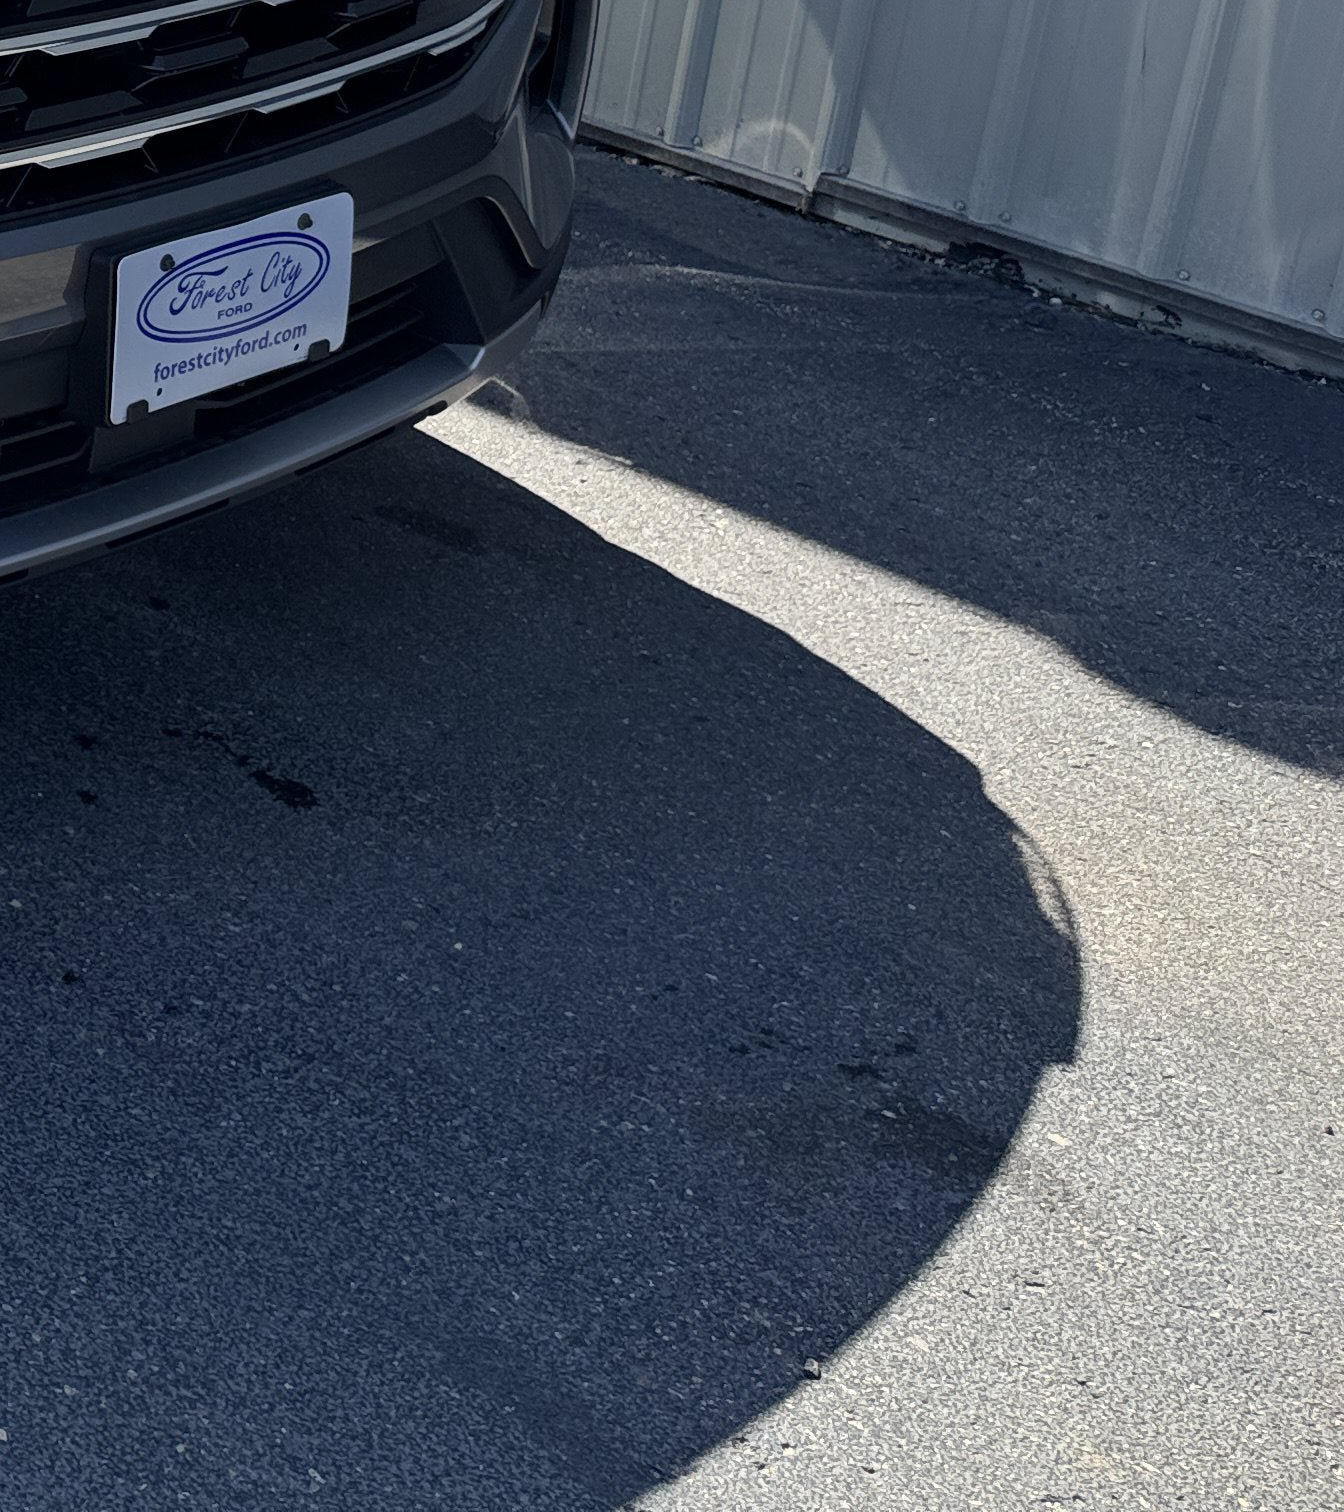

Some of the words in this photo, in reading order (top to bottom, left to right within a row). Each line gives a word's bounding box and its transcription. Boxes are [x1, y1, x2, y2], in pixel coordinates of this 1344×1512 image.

[168, 265, 254, 316] Forest
[260, 250, 303, 299] City
[216, 302, 254, 320] FORD
[153, 322, 308, 383] forestcityford.com
